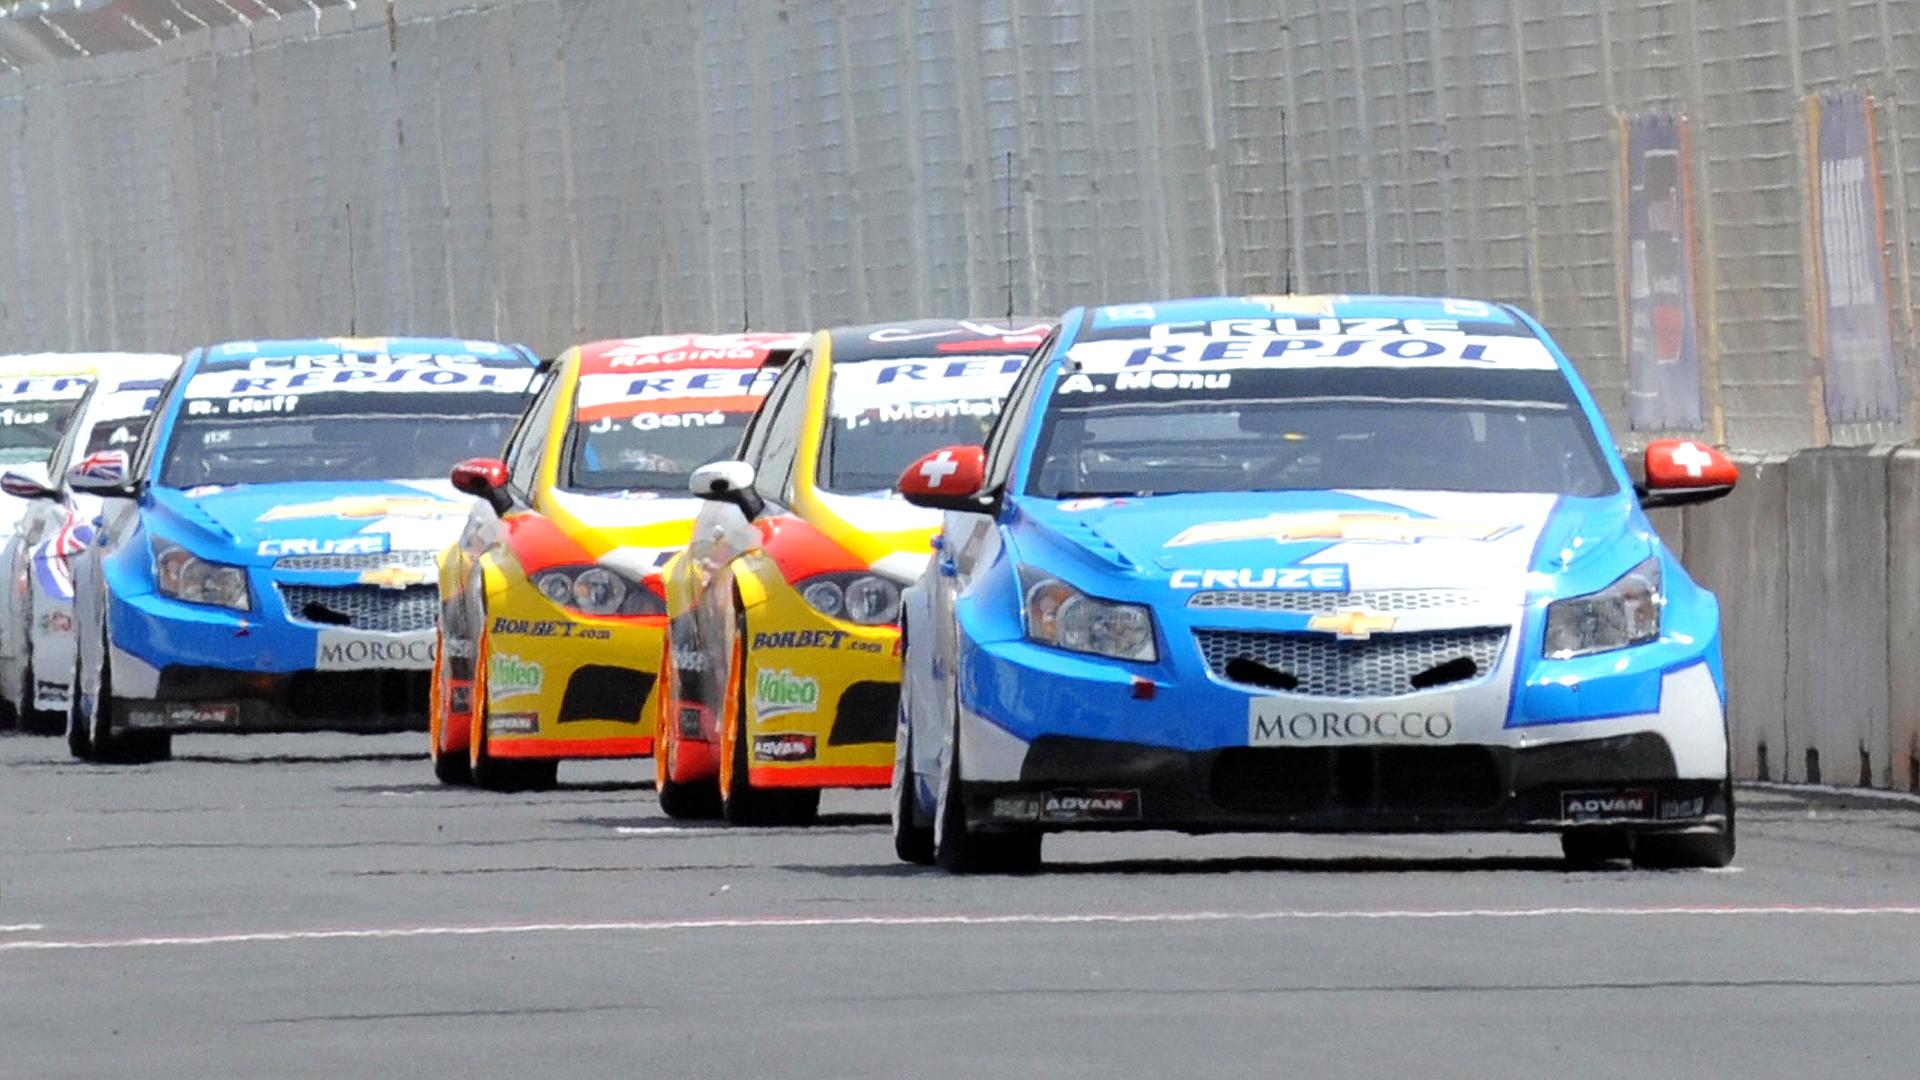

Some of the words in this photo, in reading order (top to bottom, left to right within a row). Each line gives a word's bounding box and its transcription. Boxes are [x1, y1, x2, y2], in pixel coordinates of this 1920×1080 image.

[1150, 317, 1465, 341] CRUZE
[609, 350, 755, 368] RACING
[1124, 338, 1498, 368] REPSOL
[229, 369, 503, 394] REPSOL
[1058, 373, 1107, 394] A.
[188, 400, 221, 415] R.
[589, 416, 622, 434] J.
[258, 537, 384, 557] CRUZE
[1169, 567, 1344, 590] CRUZE
[757, 672, 818, 704] Valeo
[1253, 711, 1454, 741] MOROCCO
[1045, 797, 1124, 811] ADVAN
[1568, 798, 1644, 812] ADVAN
